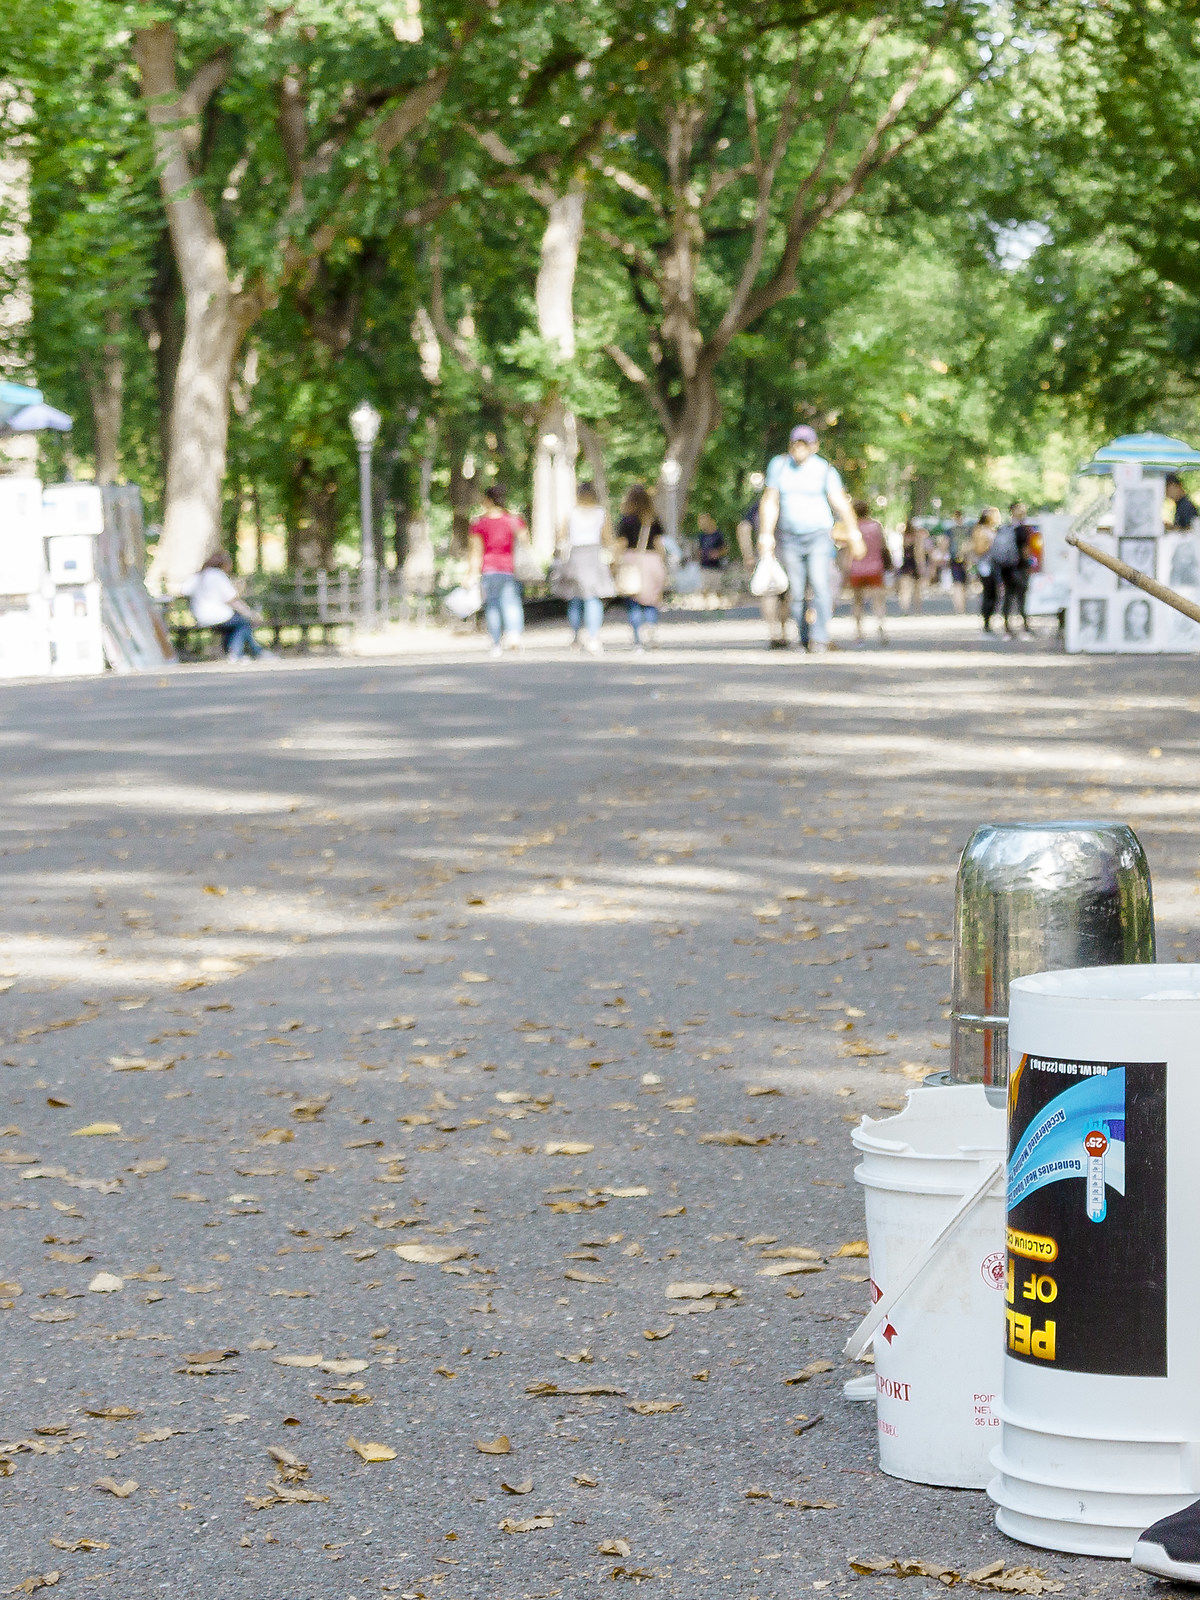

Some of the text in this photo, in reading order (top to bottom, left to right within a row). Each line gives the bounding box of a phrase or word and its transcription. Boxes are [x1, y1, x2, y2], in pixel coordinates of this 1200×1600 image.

[1067, 1064, 1077, 1074] 50
[1093, 1066, 1108, 1076] Net
[1028, 1109, 1065, 1153] Accelerated
[1038, 1160, 1081, 1177] Generates
[1024, 1170, 1038, 1187] Heat
[1015, 1236, 1053, 1255] CALCIUM
[1023, 1273, 1058, 1303] OF
[975, 1418, 1000, 1426] 35 LB
